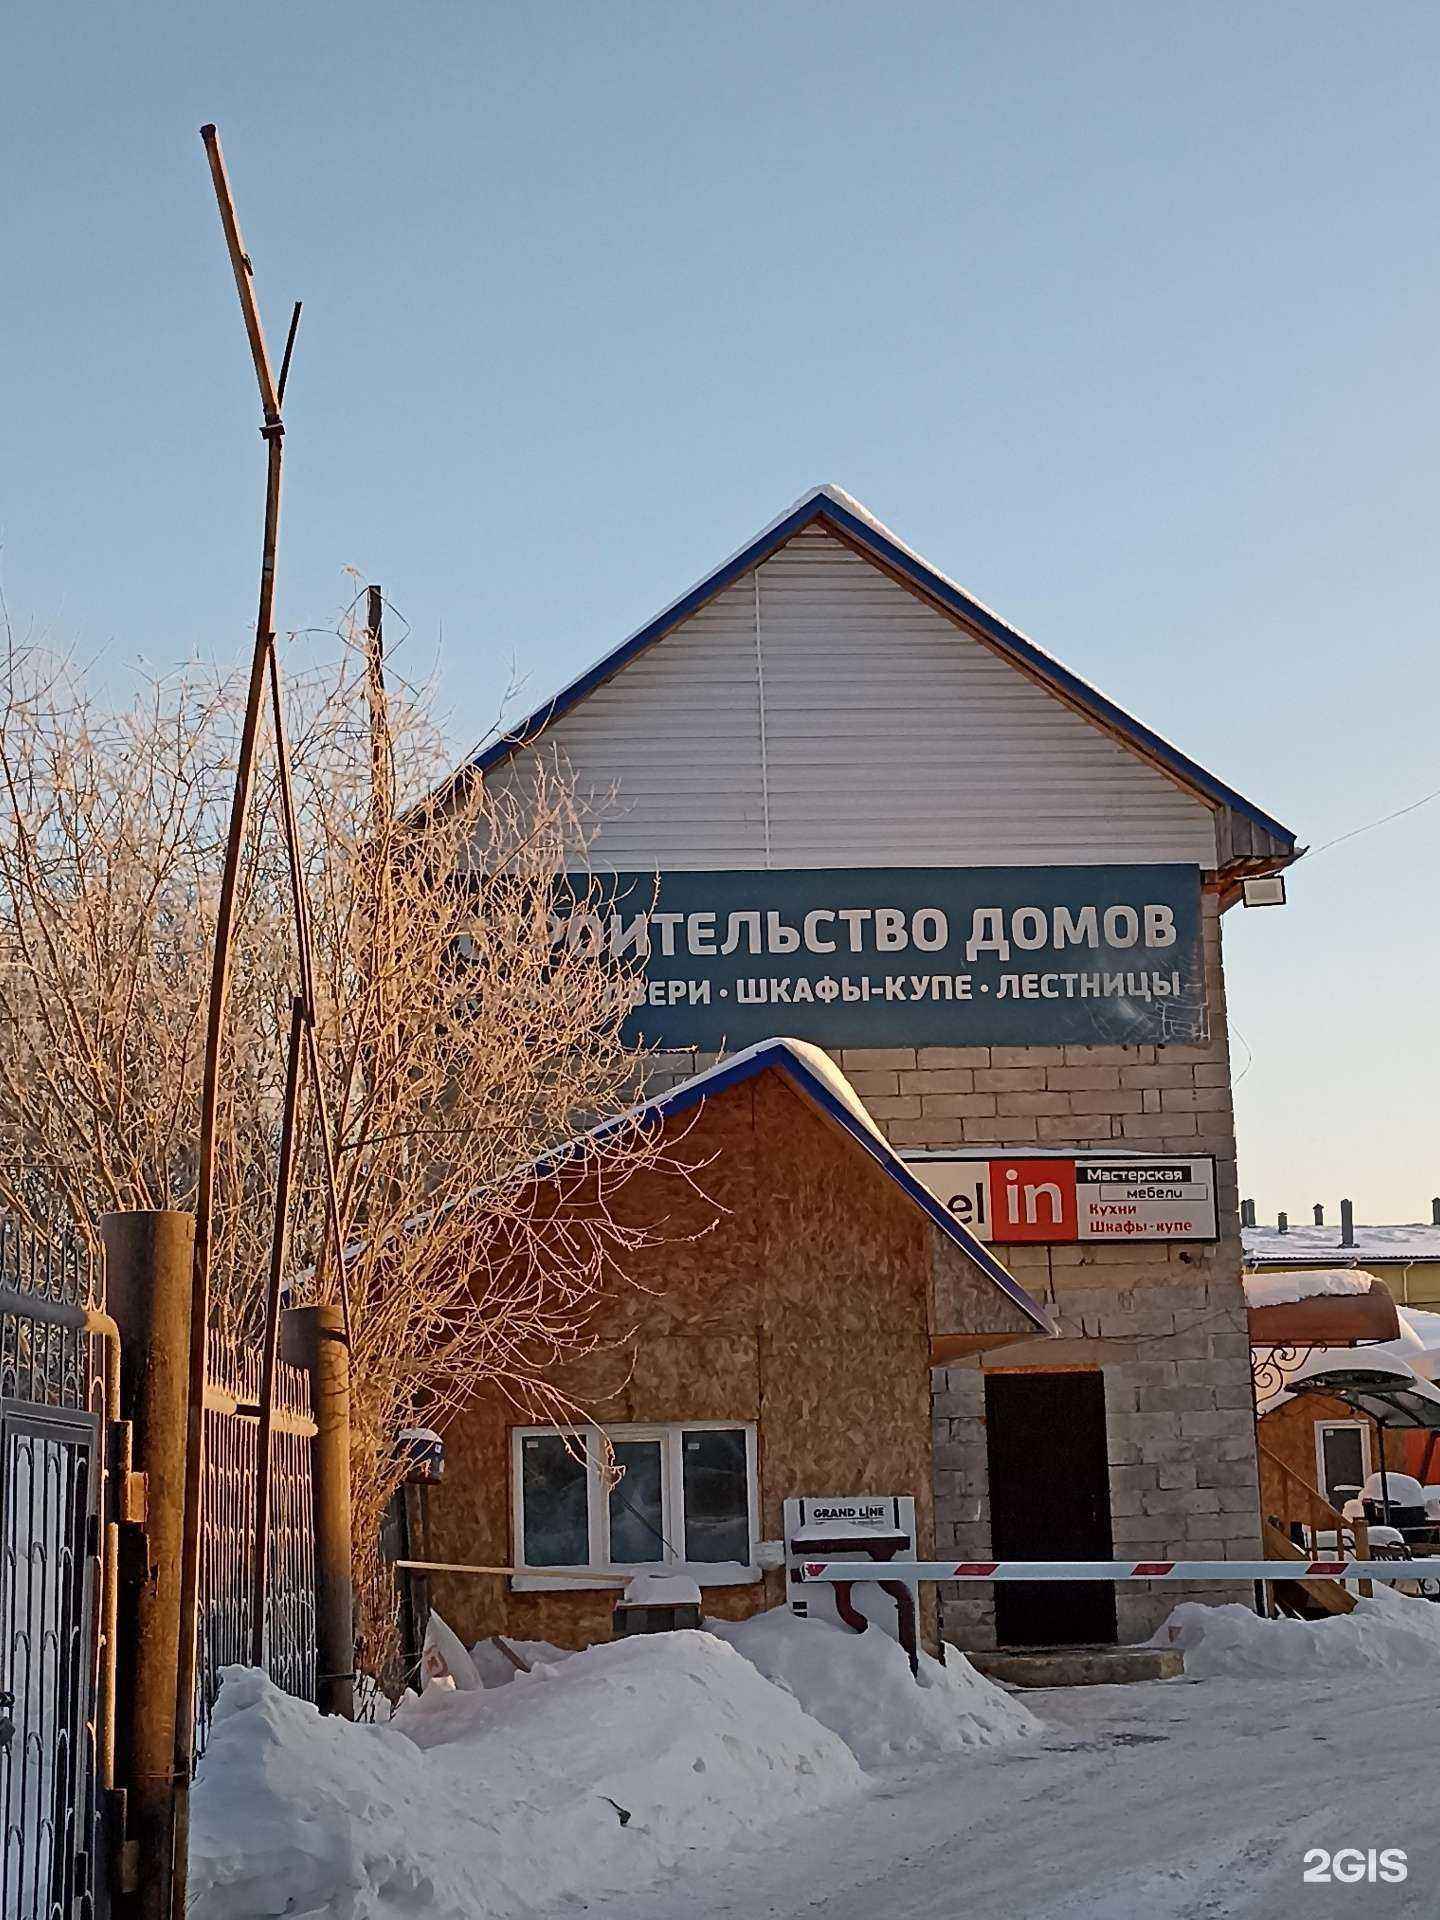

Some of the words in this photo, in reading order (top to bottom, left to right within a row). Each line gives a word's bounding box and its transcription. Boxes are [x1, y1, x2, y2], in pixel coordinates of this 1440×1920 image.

[457, 908, 948, 960] ОИТЕЛЬСТВО
[966, 904, 1178, 961] ДОМОВ
[736, 974, 973, 1004] ШКАФЫ-КУПЕ
[996, 970, 1180, 1002] ЛЕСТНИЦЫ
[1086, 1168, 1183, 1183] Мастерская
[1126, 1186, 1183, 1199] мебели
[1089, 1203, 1137, 1216] Кухни
[813, 1508, 856, 1518] GRAND
[858, 1506, 885, 1518] LINE
